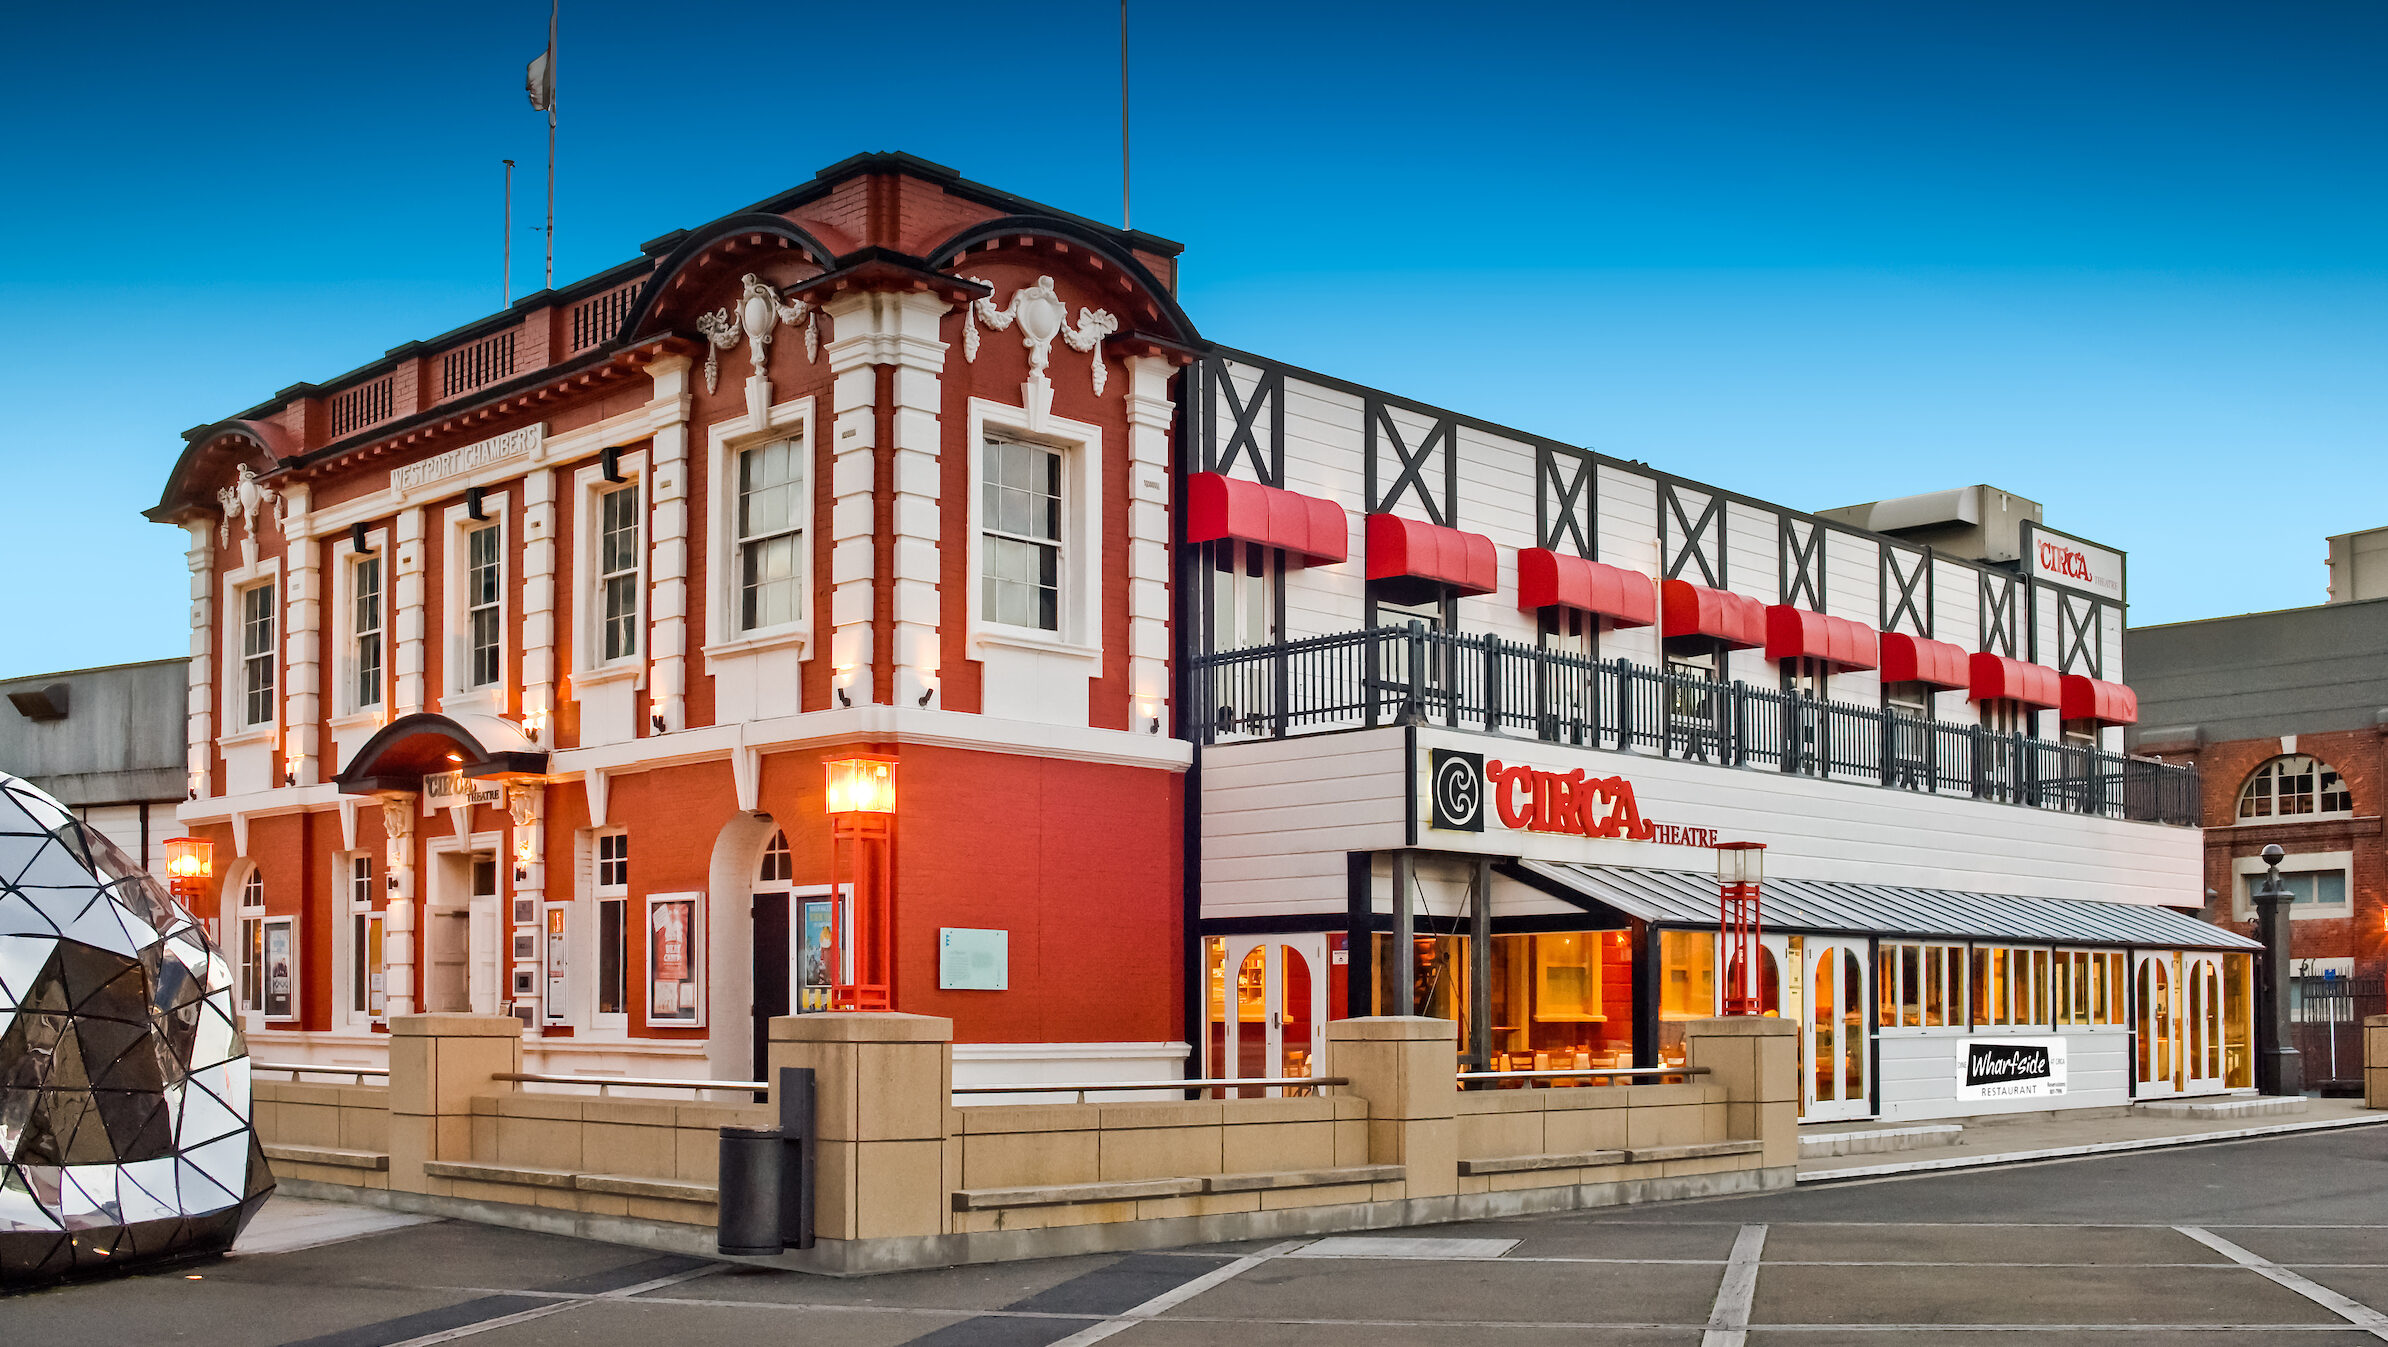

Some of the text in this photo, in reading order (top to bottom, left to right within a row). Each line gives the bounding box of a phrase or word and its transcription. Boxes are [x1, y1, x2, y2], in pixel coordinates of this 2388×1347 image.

[391, 425, 537, 491] WESTPORT CHAMBERS
[2037, 538, 2093, 582] CIRCA
[466, 789, 500, 803] THEATRE
[1485, 759, 1718, 848] CIRCA THEATRE
[1972, 1050, 2046, 1078] Wharfside
[1981, 1085, 2037, 1097] RESTAURANT
